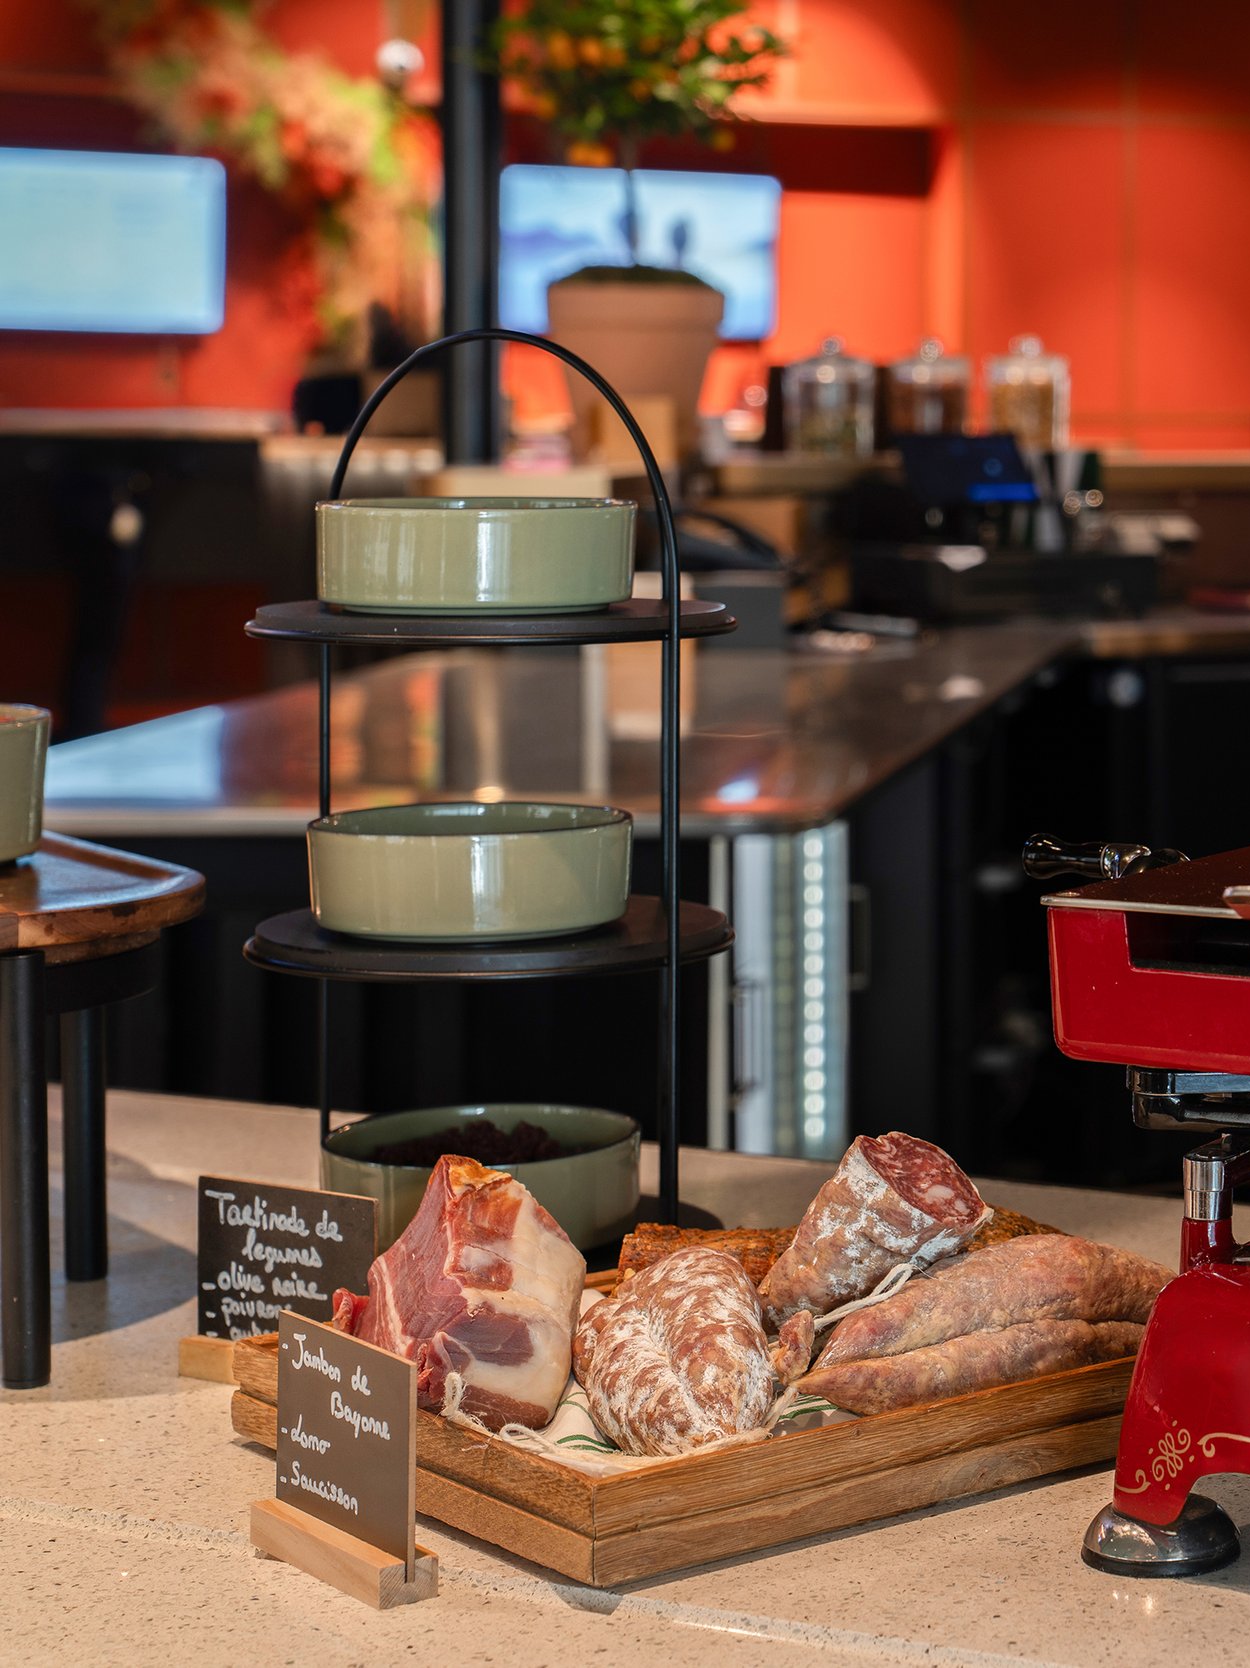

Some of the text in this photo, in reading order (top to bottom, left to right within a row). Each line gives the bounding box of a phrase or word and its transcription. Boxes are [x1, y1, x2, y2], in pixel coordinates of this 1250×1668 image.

[315, 1210, 343, 1242] de
[351, 1365, 371, 1396] de
[330, 1391, 391, 1441] Bayonne
